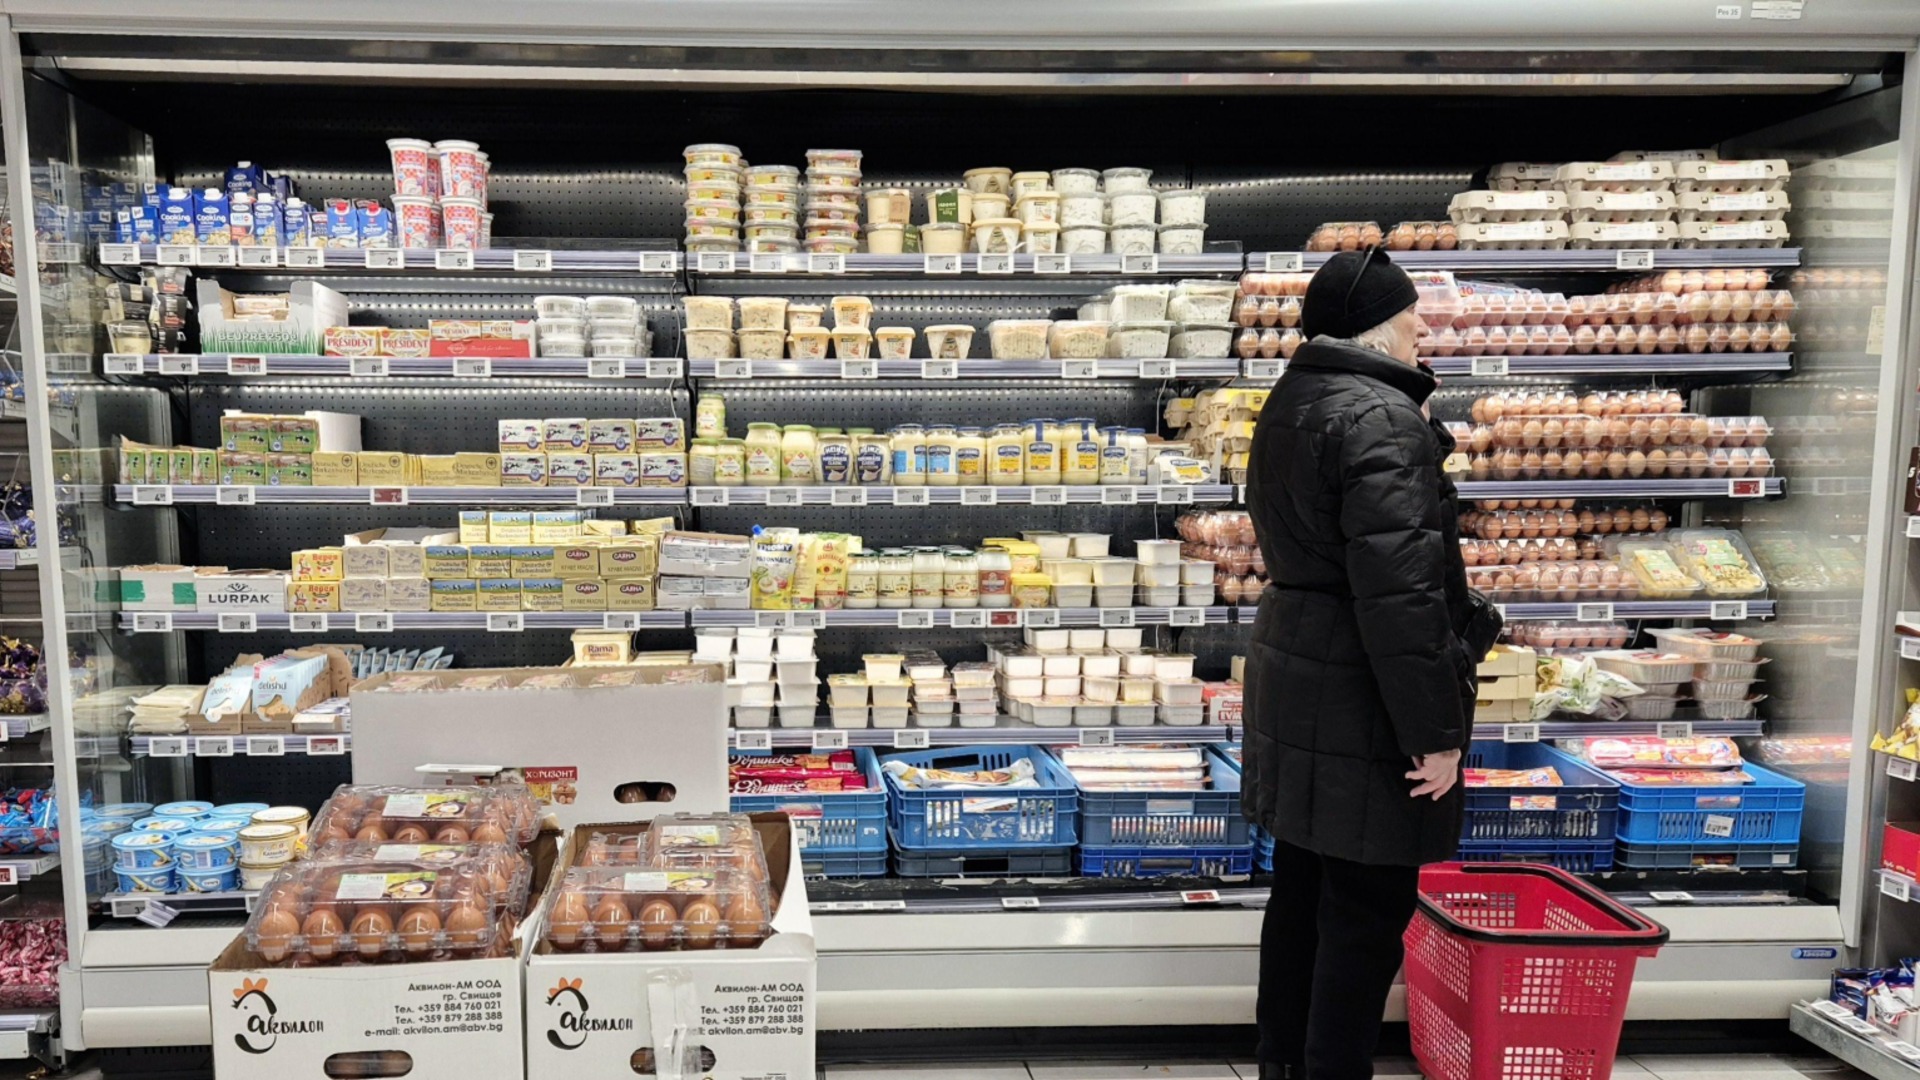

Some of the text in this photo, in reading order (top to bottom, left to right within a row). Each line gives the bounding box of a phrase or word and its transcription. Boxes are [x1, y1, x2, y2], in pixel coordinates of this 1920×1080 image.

[160, 213, 191, 223] Cooking
[196, 213, 227, 223] Cooking
[327, 335, 373, 348] PRÉSIDENT
[382, 336, 428, 349] PRÉSIDENT
[312, 553, 338, 561] Верея
[208, 594, 270, 603] LURPAK
[525, 769, 575, 779] ХОРИЗОНТ
[407, 980, 502, 992] Аквилон-АМ ООД
[714, 983, 804, 993] Аквилон-АМ ООД
[443, 991, 502, 1002] гр. Свищов
[747, 994, 804, 1003] гр. Свищов
[394, 1001, 501, 1014] Тел. +359 884 760 021
[701, 1004, 803, 1014] Тел. +359 884 760 021
[395, 1011, 503, 1025] Тел. +359 879 288 388
[701, 1014, 804, 1025] Тел. +359 879 288 388
[364, 1022, 503, 1037] e-mail: akvilon.am@abv.bg
[708, 1025, 804, 1036] akvilon.am@abv.bg
